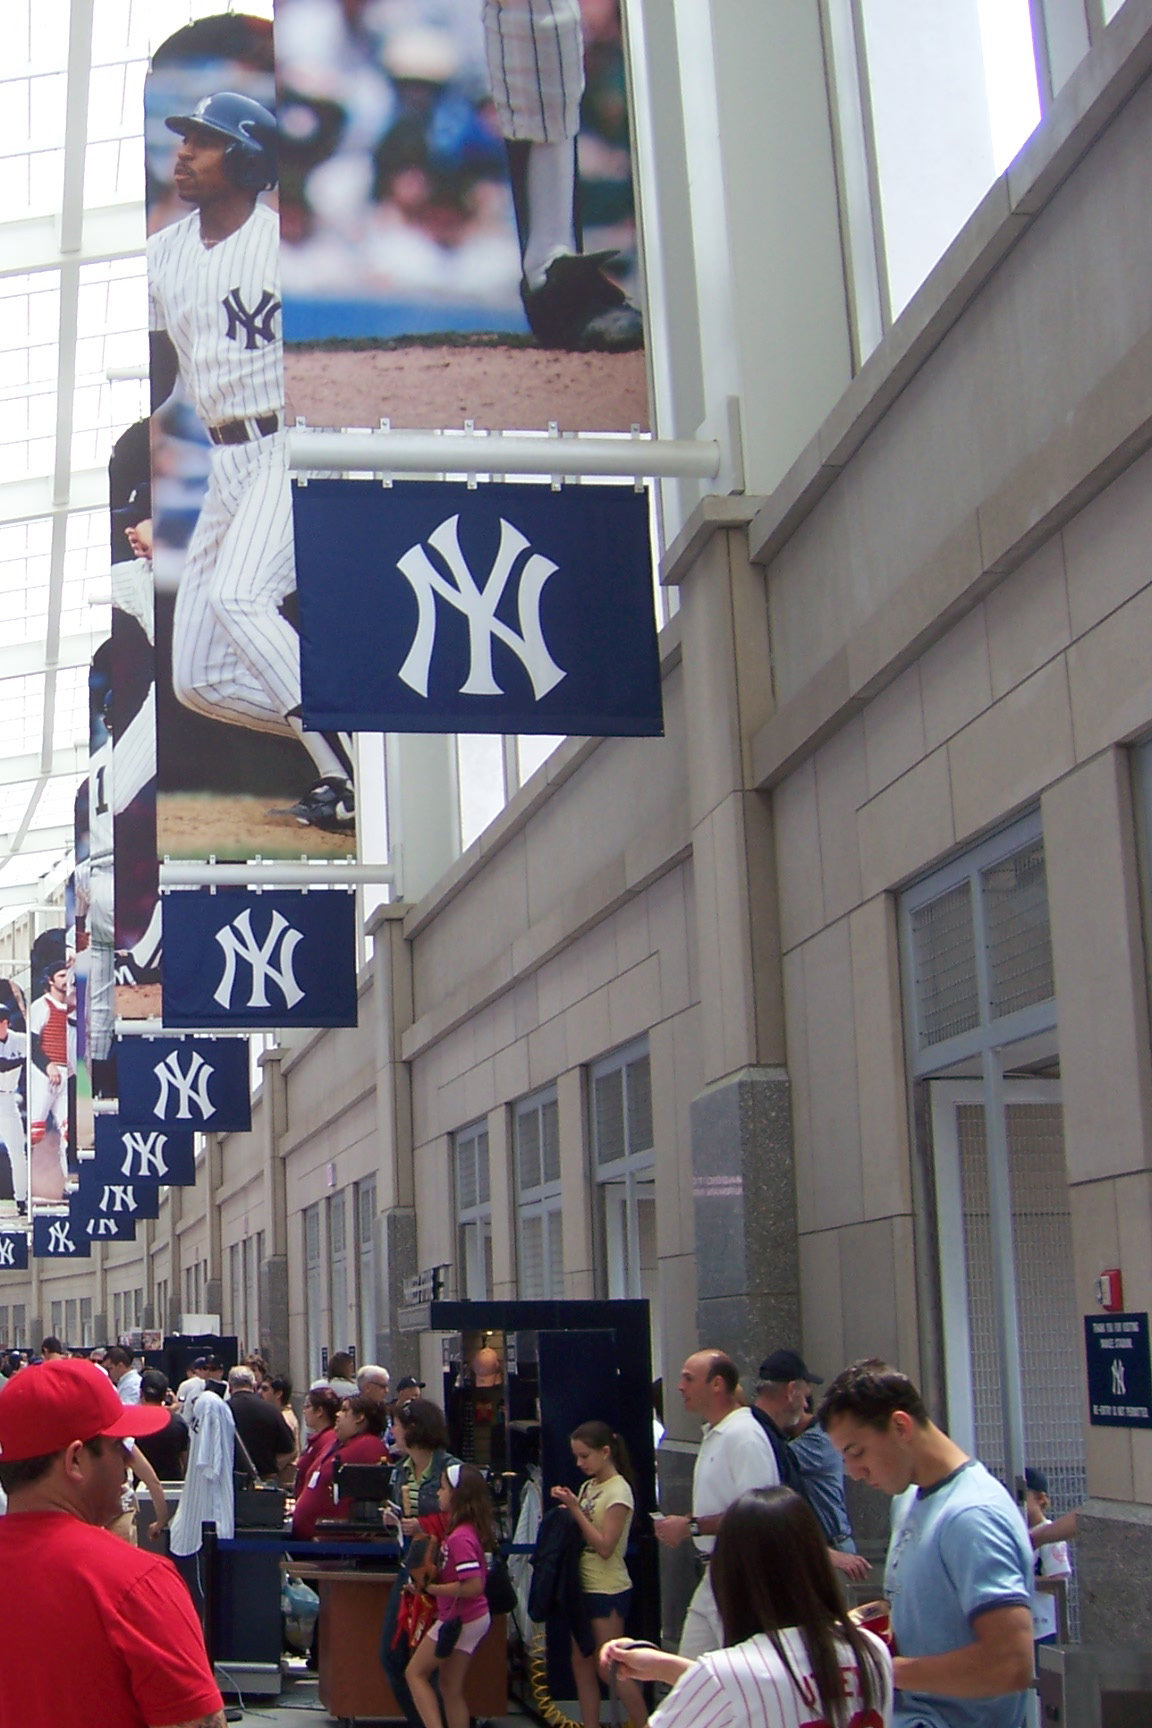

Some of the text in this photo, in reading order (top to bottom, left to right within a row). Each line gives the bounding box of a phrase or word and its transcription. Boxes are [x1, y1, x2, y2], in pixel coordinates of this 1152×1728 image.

[396, 514, 567, 701] NY
[214, 908, 305, 1009] NY
[153, 1050, 217, 1120] NY
[121, 1131, 169, 1177] NY
